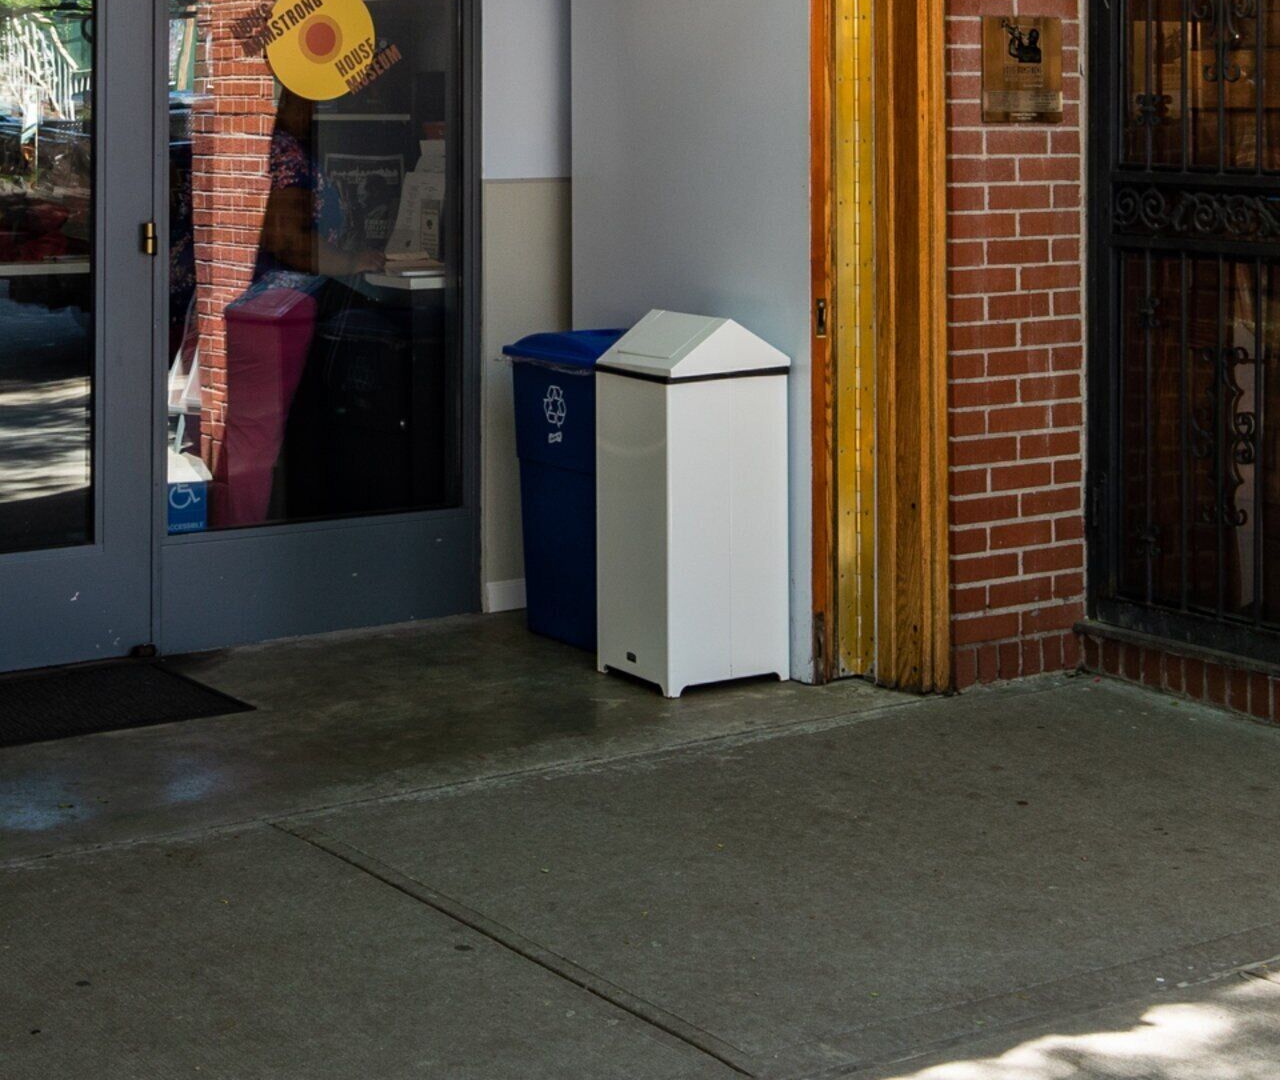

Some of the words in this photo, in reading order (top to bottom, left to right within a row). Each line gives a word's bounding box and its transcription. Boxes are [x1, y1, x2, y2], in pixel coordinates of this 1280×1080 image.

[229, 3, 273, 38] LOUIS
[334, 37, 375, 78] HOUSE
[344, 44, 403, 95] MUSEUM
